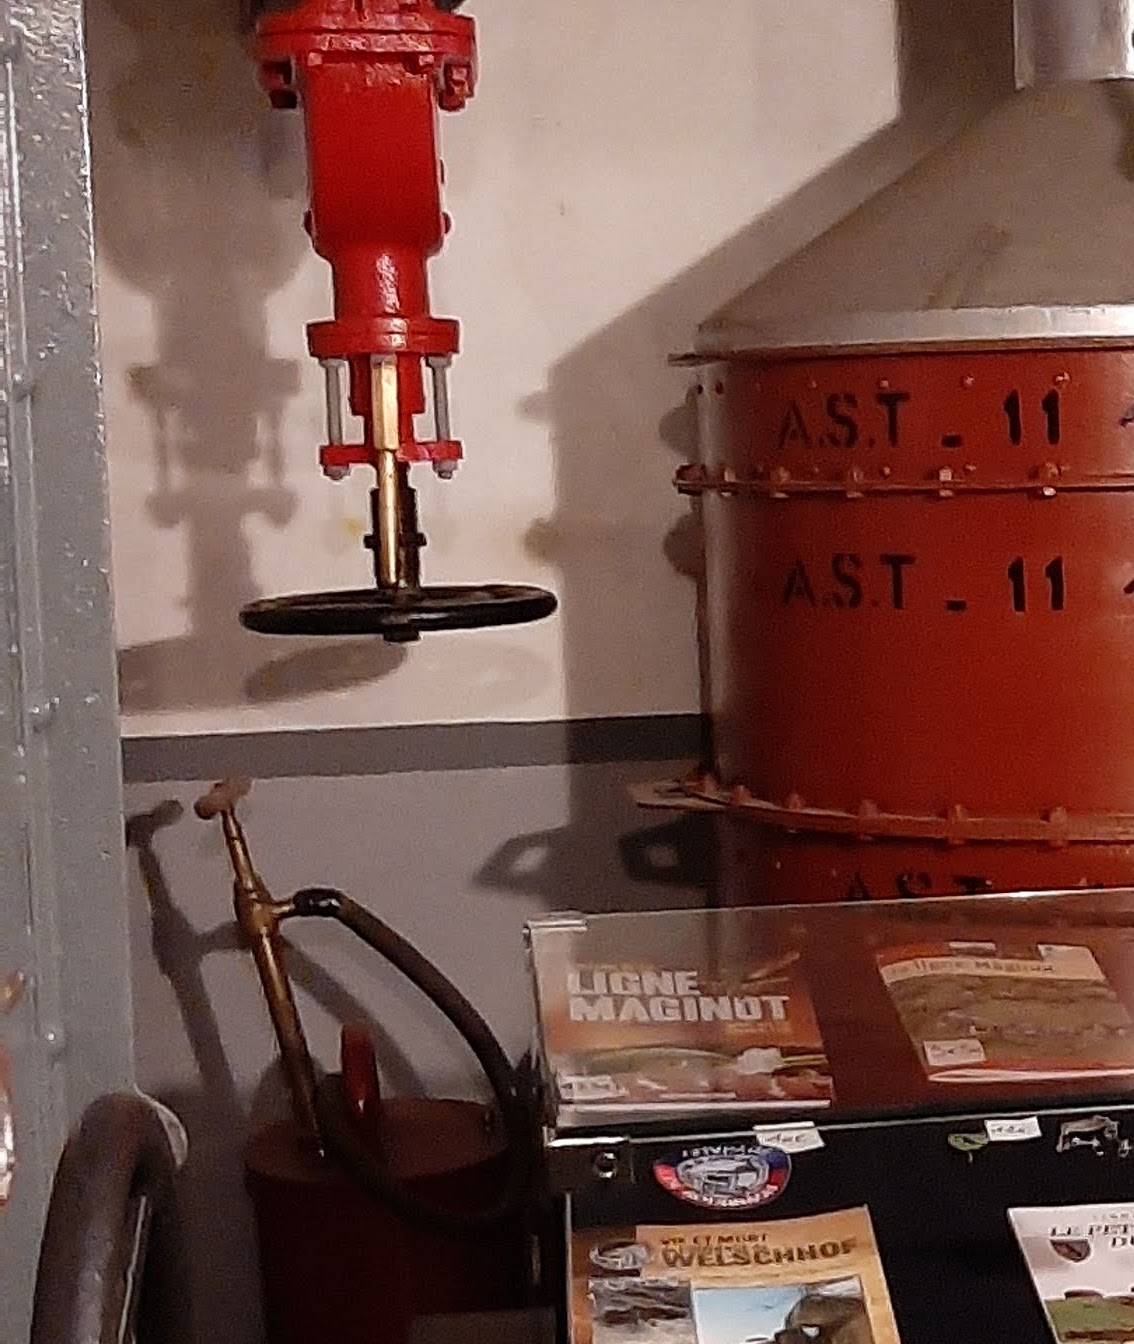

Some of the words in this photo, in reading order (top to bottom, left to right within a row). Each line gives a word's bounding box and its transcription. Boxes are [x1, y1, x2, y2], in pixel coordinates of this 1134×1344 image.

[567, 970, 701, 995] LIGNE
[569, 996, 790, 1022] MAGINOT
[662, 1238, 858, 1267] WELSCHHOF
